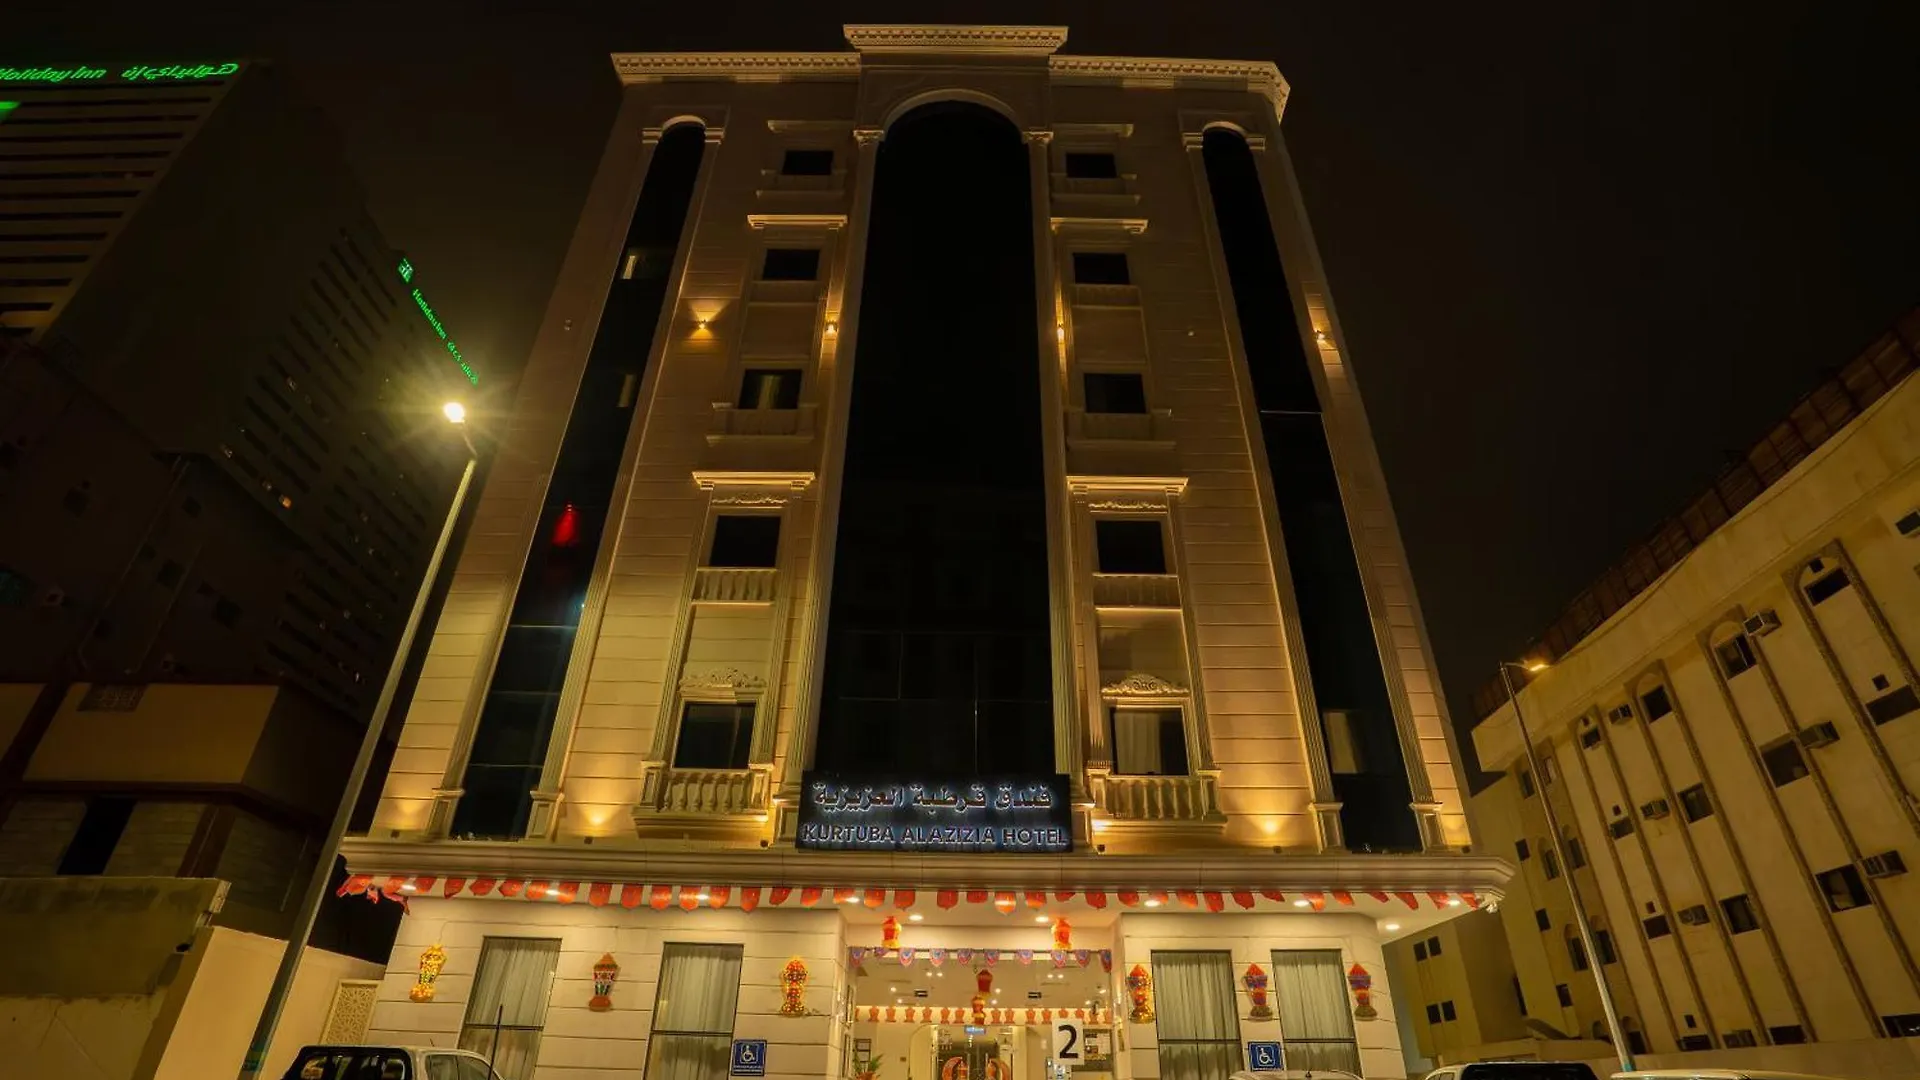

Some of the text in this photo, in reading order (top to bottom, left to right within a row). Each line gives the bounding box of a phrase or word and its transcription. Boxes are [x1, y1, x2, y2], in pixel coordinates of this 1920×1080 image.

[70, 66, 107, 79] Inn
[812, 782, 1053, 815] فندق قرطبة العزيزية
[802, 823, 1068, 846] KURTUBA ALAZIZIA HOTEL
[1058, 1024, 1079, 1059] 2
